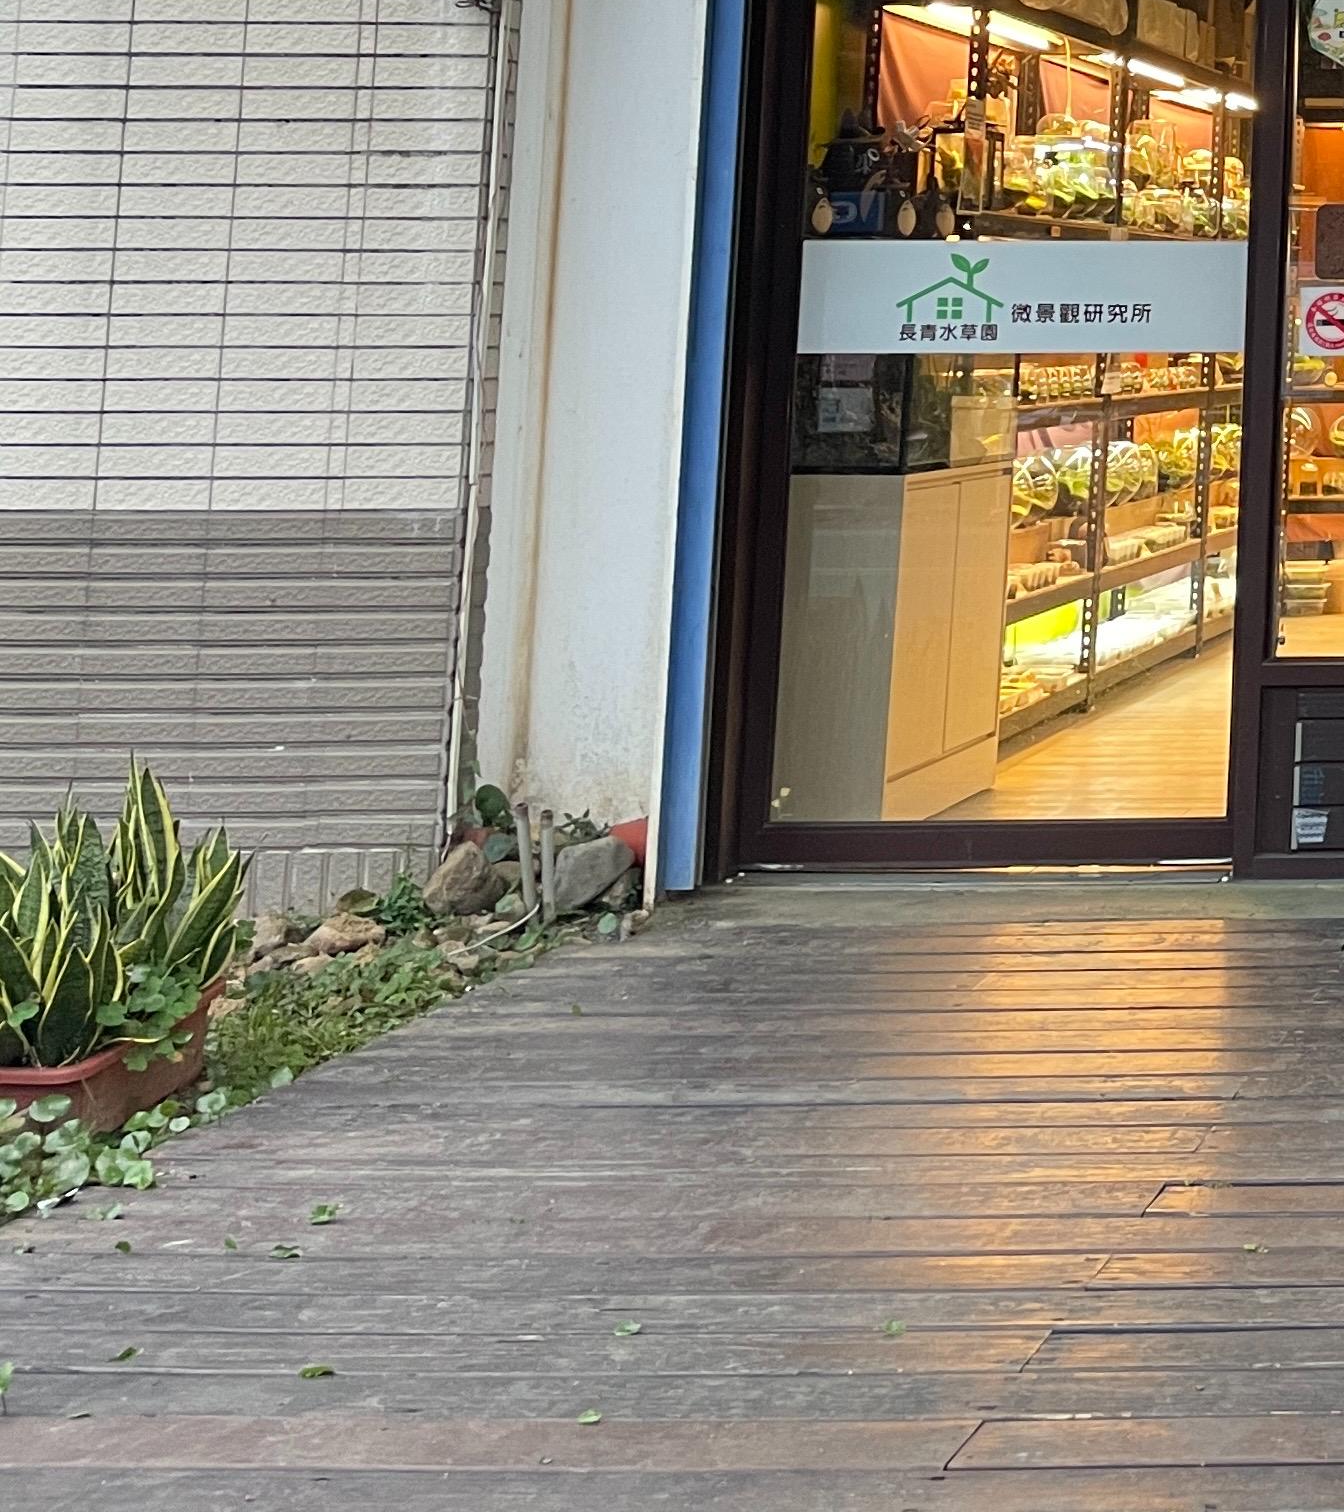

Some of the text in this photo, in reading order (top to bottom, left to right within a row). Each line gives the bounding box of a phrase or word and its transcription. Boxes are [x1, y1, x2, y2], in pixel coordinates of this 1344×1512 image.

[1011, 303, 1152, 324] 微景觀研究所
[899, 323, 998, 342] 長青水草園
